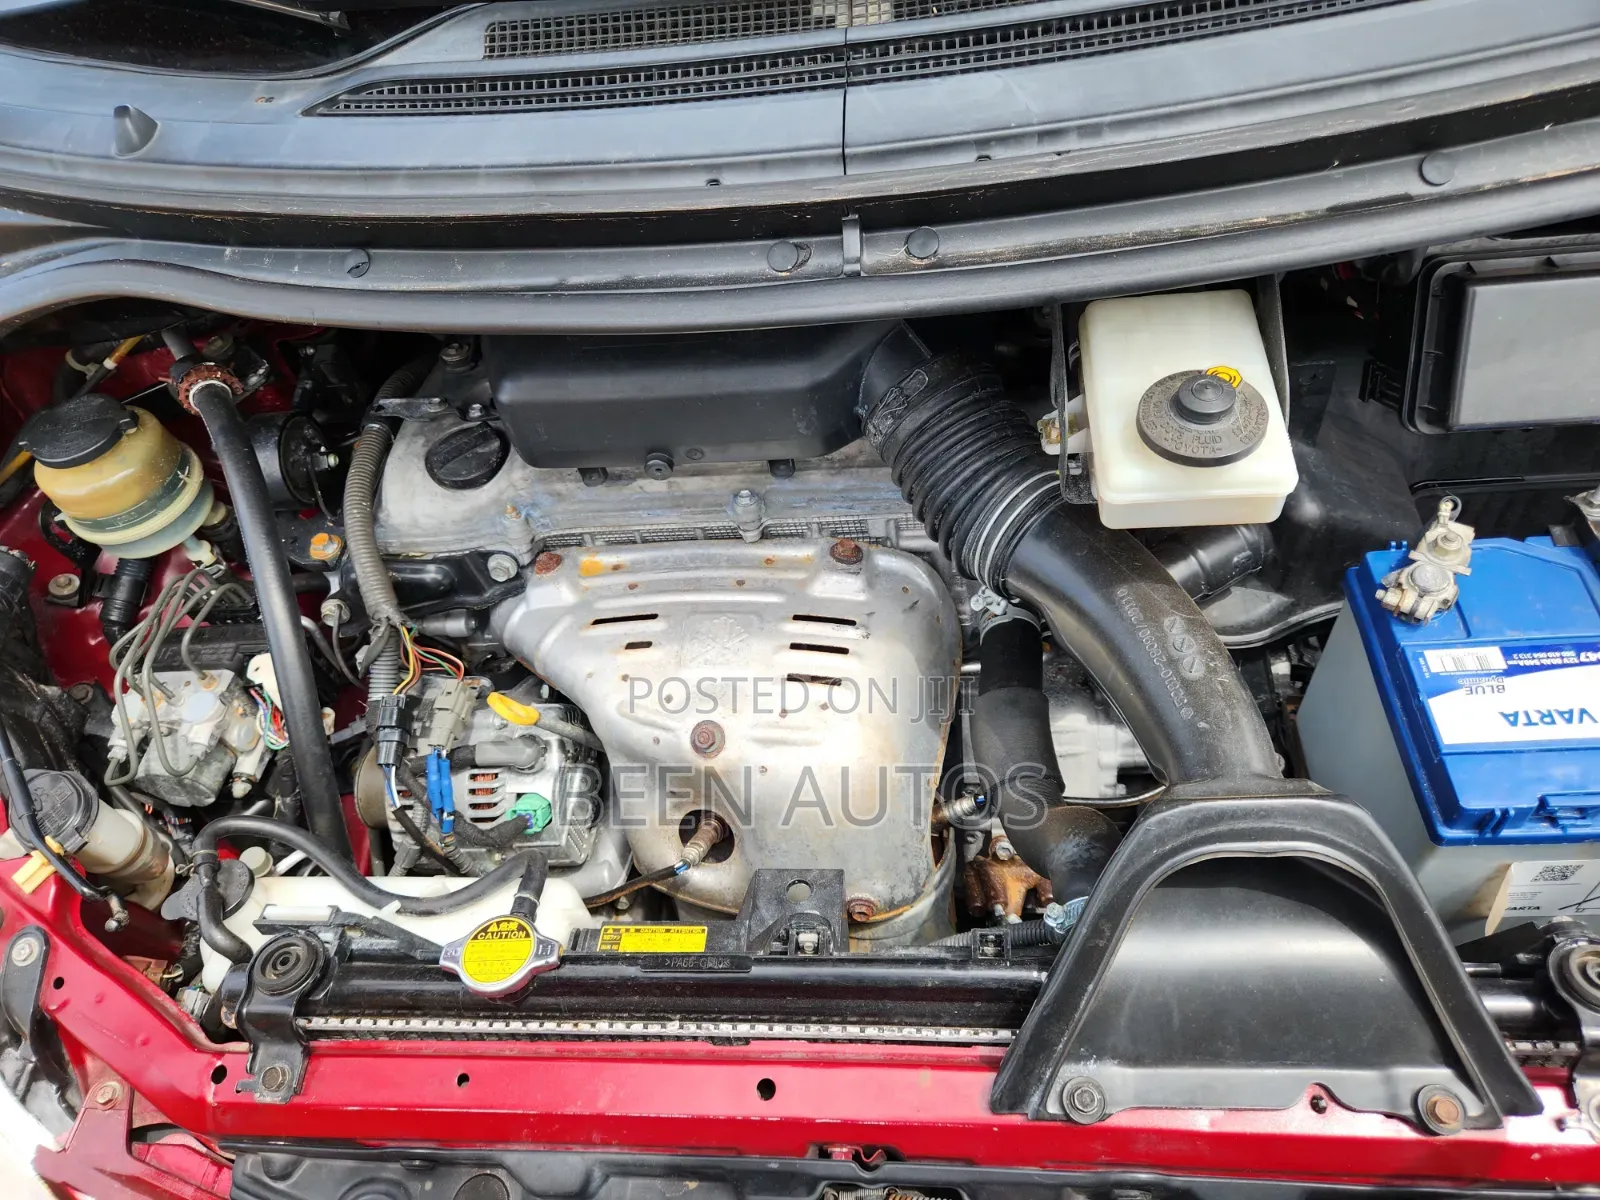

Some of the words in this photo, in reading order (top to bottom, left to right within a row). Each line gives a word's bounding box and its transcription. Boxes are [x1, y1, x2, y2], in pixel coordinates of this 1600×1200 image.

[1192, 435, 1222, 445] FLUID
[1458, 676, 1505, 686] Dynamic
[1465, 684, 1505, 695] BLUE
[1498, 707, 1599, 727] VARTA
[477, 930, 527, 940] CAUTION
[538, 945, 551, 955] 1.1
